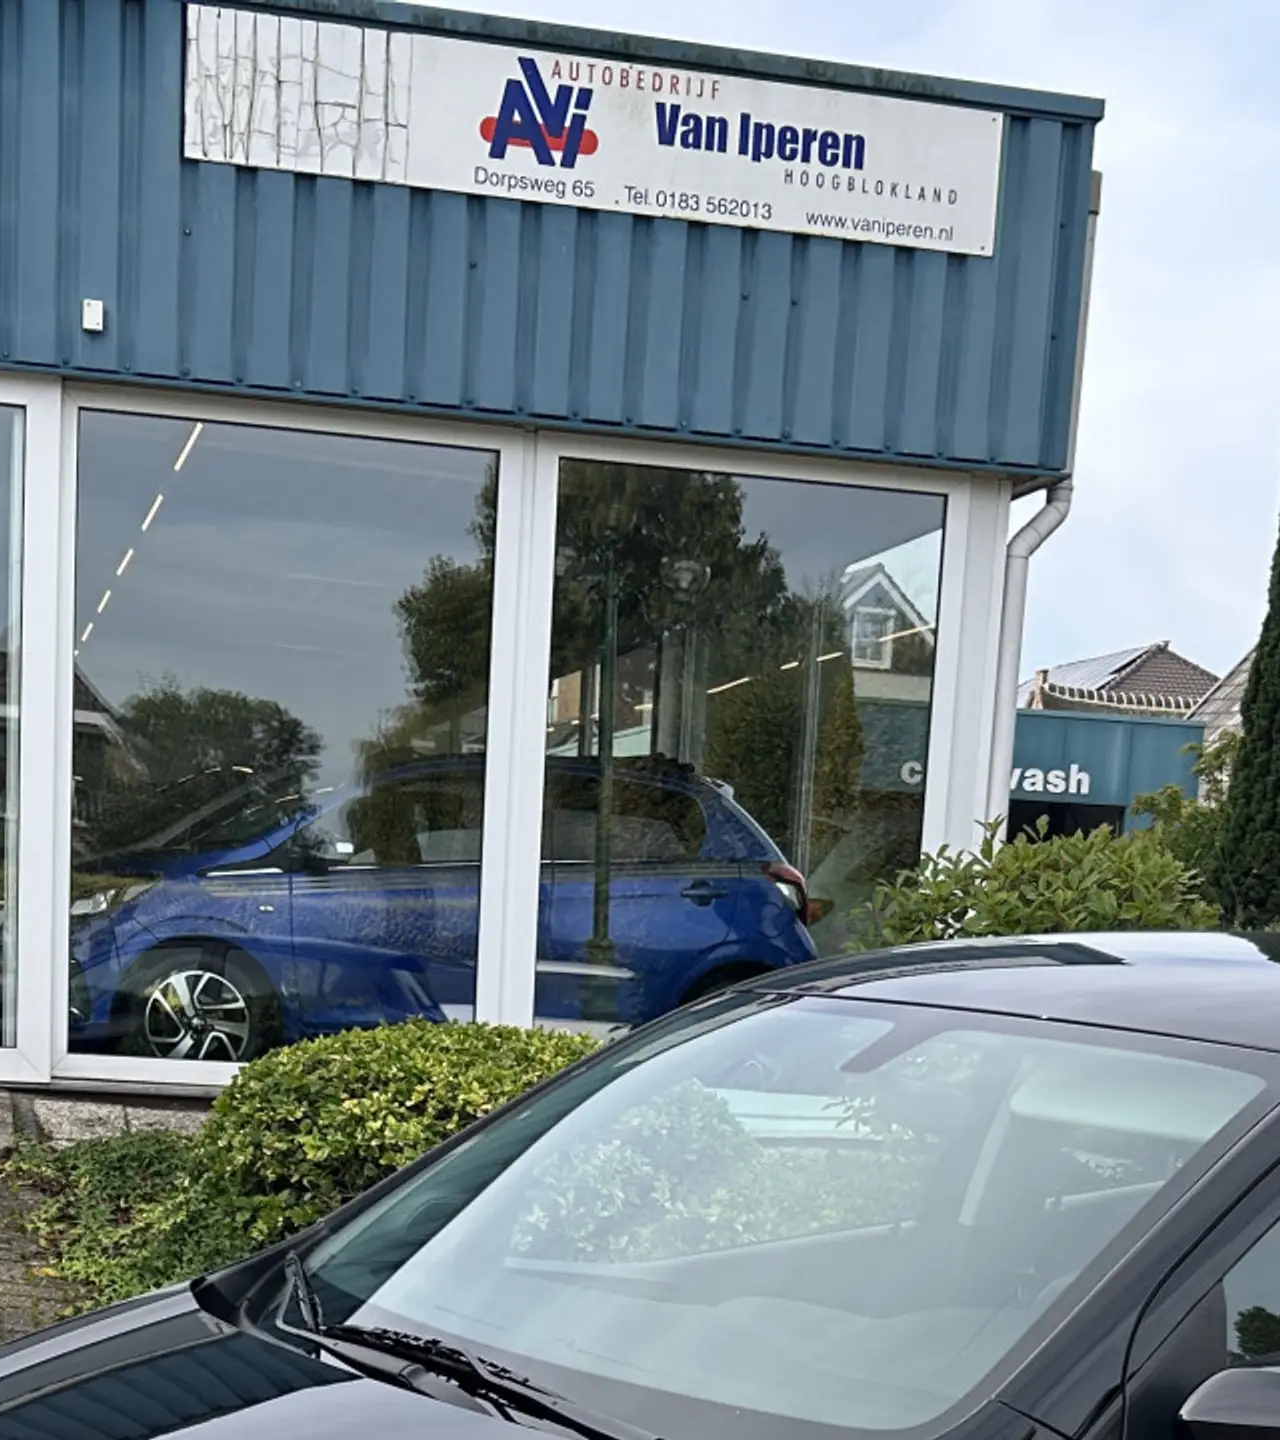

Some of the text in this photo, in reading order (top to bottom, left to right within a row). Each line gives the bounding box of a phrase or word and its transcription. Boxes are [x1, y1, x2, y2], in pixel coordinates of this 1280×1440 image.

[551, 59, 721, 99] AUTOBEDRIJF
[654, 101, 866, 170] Van Iperen
[473, 166, 596, 199] Dorpsweg 65
[783, 168, 958, 205] HOOGBLOKLAND
[656, 190, 700, 211] 0183
[706, 197, 773, 220] 562013
[806, 210, 954, 241] www.vaniperen.nl
